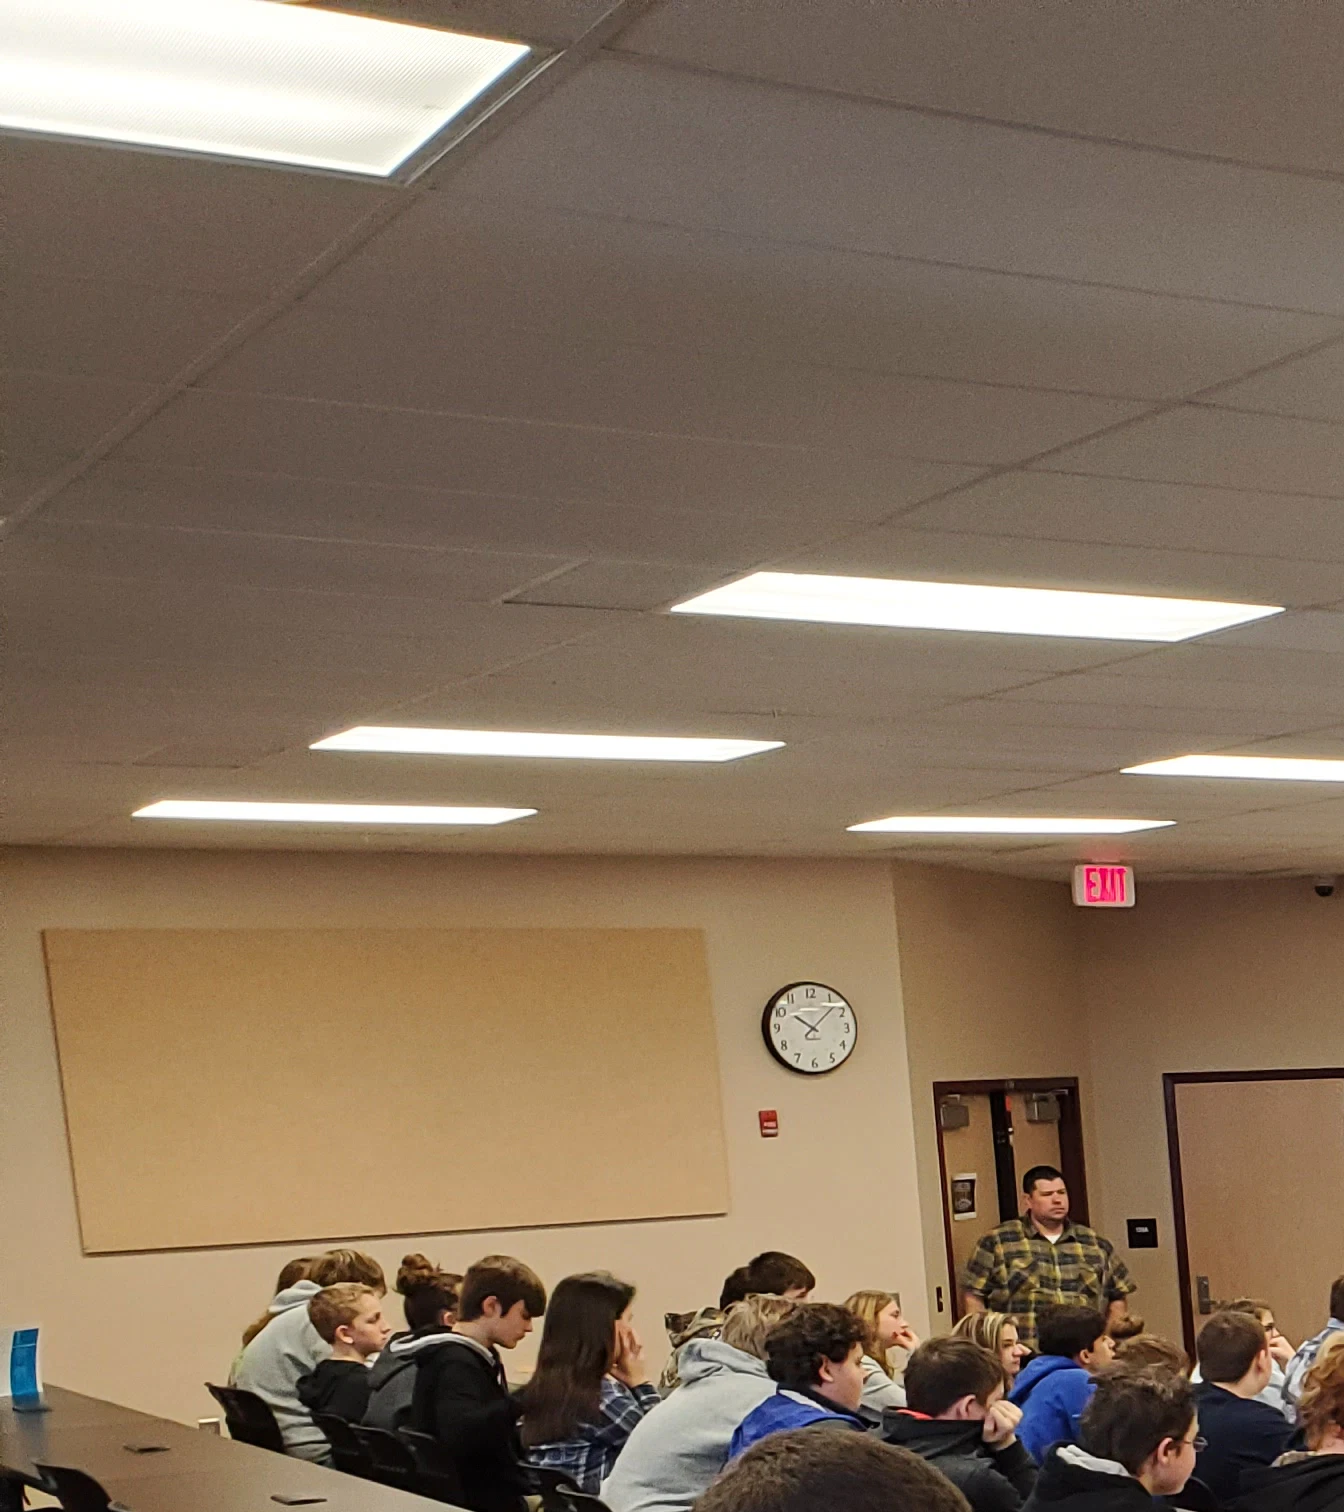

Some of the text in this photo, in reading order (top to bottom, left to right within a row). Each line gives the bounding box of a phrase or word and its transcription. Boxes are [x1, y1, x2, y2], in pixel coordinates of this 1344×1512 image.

[1084, 867, 1126, 903] EXIT
[786, 993, 795, 1005] 11
[805, 987, 816, 999] 12
[775, 1007, 787, 1018] 10
[838, 1007, 846, 1018] 2
[773, 1023, 781, 1034] 9
[843, 1022, 850, 1034] 3
[780, 1039, 788, 1051] 8
[839, 1039, 846, 1051] 4
[794, 1052, 801, 1064] 7
[811, 1057, 819, 1069] 6
[829, 1052, 836, 1064] 5
